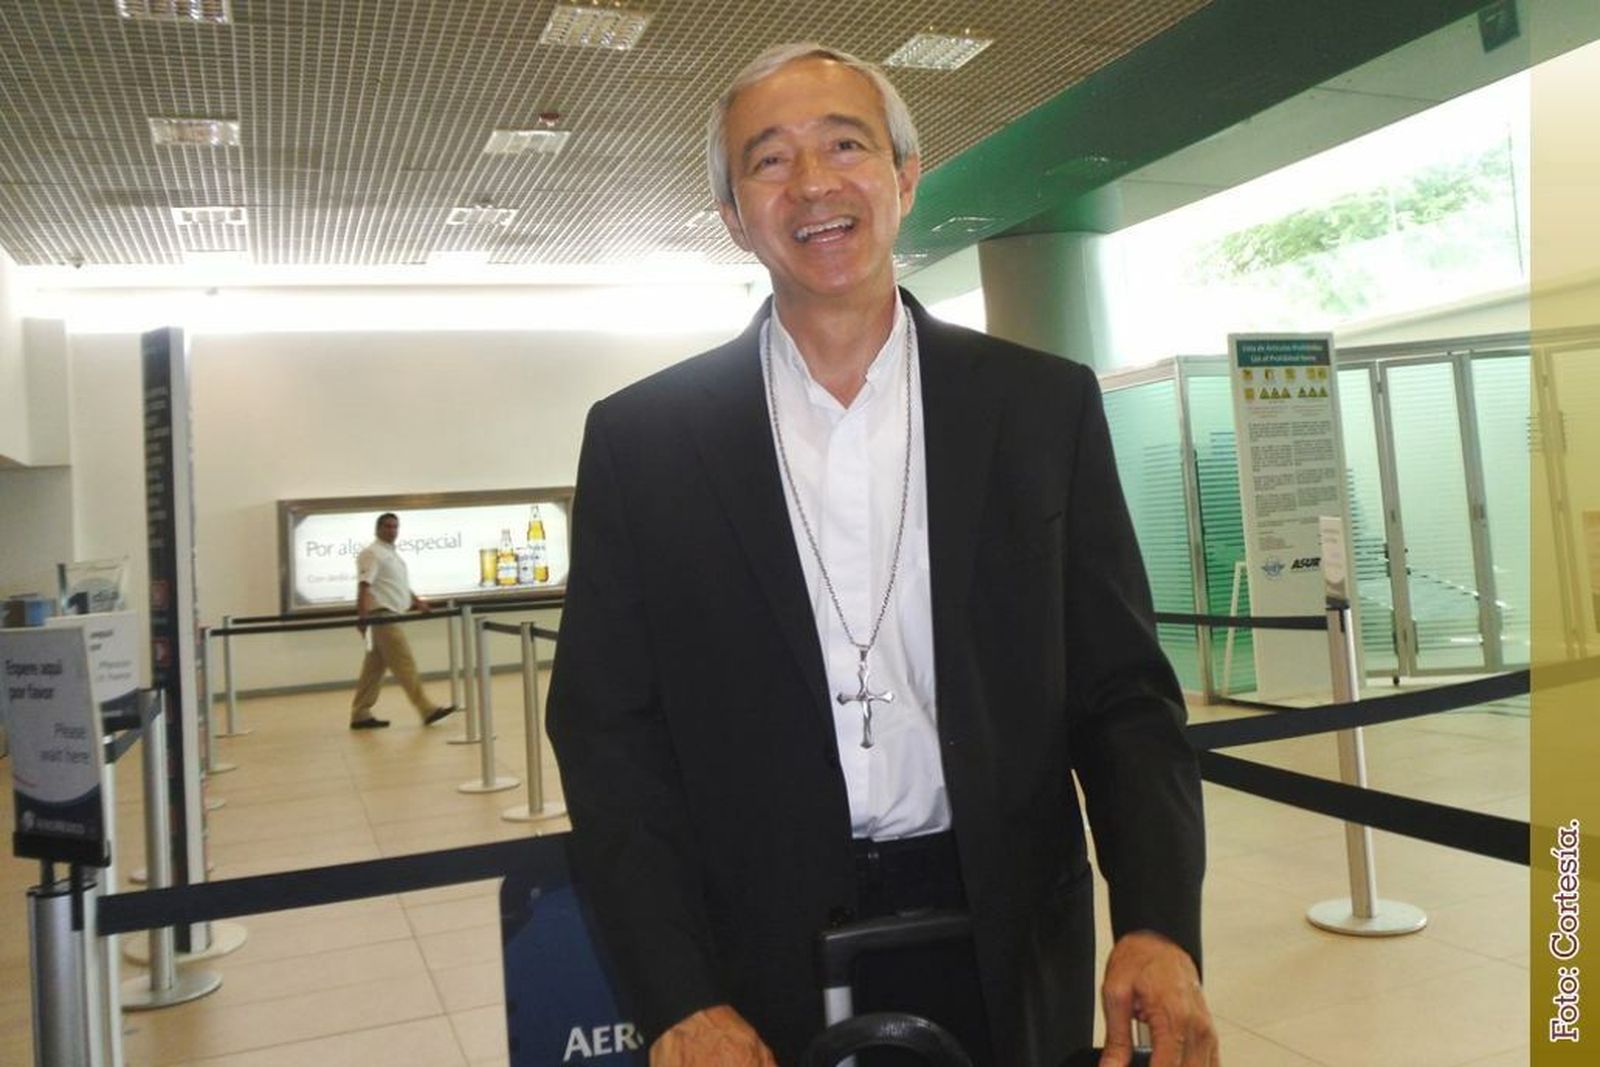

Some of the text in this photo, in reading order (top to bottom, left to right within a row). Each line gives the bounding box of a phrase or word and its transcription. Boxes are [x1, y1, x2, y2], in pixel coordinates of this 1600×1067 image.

[306, 541, 332, 557] Por
[399, 532, 461, 554] especial
[563, 1021, 645, 1062] AER
